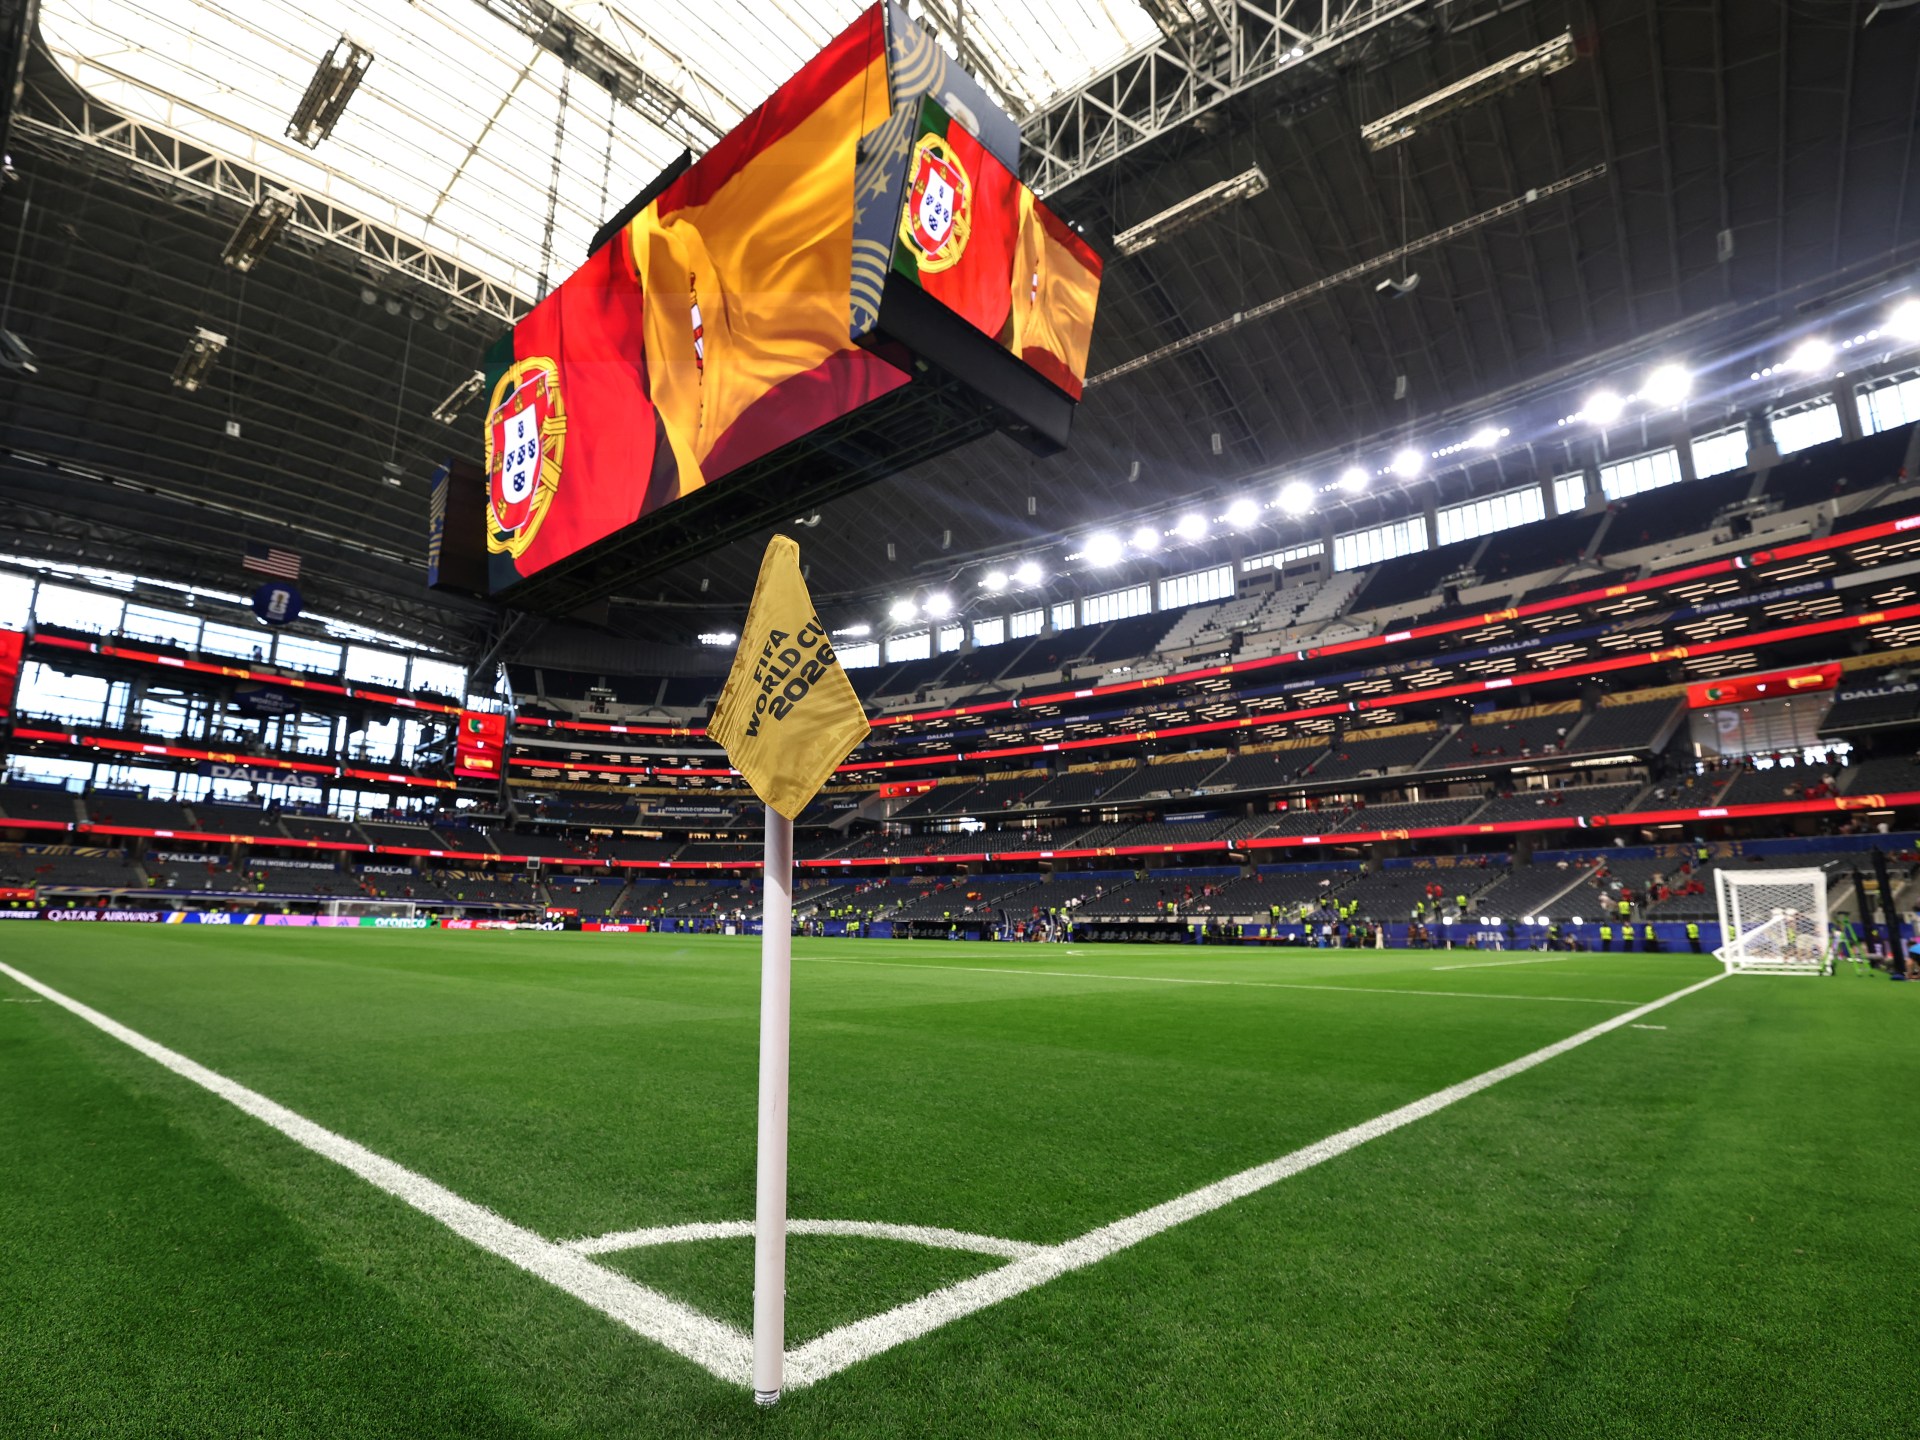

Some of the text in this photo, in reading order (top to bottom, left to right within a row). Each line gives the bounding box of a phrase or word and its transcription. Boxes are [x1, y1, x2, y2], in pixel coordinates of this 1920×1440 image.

[1720, 594, 1759, 609] WORLD
[1760, 589, 1781, 601] CUP
[1488, 638, 1541, 654] DALLAS
[753, 629, 790, 684] FIFA
[768, 643, 837, 721] 2026
[746, 648, 801, 737] WORLD
[1841, 683, 1918, 701] DALLAS
[927, 732, 954, 740] DALLAS
[211, 765, 318, 788] DALLAS
[268, 860, 292, 868] WORLD
[292, 861, 309, 869] CUP
[363, 865, 413, 876] DALLAS
[48, 910, 159, 923] QATAR AIRWAYS
[198, 913, 231, 925] VISA
[600, 924, 629, 932] Lenovo
[1476, 931, 1504, 942] FIFA
